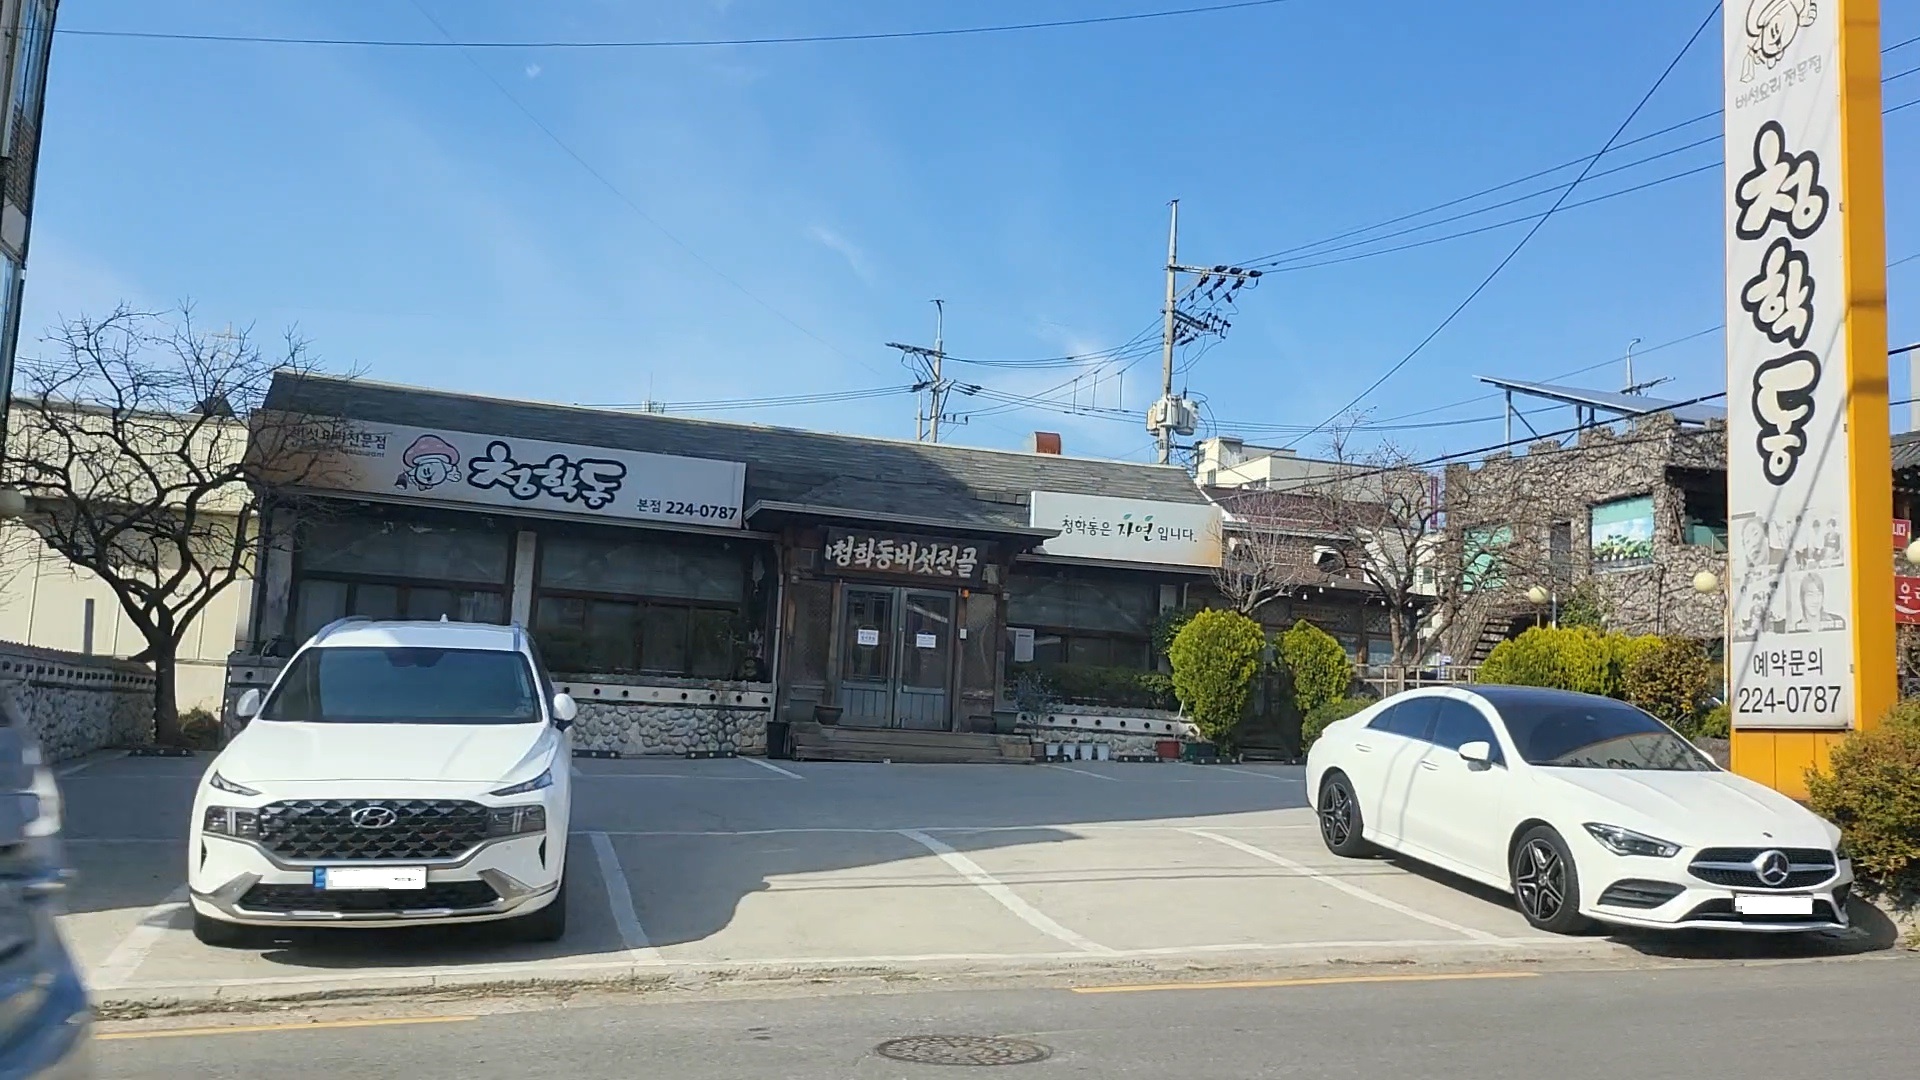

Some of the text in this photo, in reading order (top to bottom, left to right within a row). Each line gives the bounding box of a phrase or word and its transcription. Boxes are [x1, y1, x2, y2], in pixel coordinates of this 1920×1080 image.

[1735, 74, 1782, 109] 버섯요리
[1735, 120, 1829, 486] 청학동
[467, 440, 627, 510] 청학동
[637, 498, 737, 520] 본점 224-0787
[1062, 515, 1198, 543] 청학동은 자연 입니다.
[832, 535, 978, 579] 청학동버섯전골
[1753, 647, 1823, 678] 예약문의
[1739, 685, 1841, 714] 224-0787
